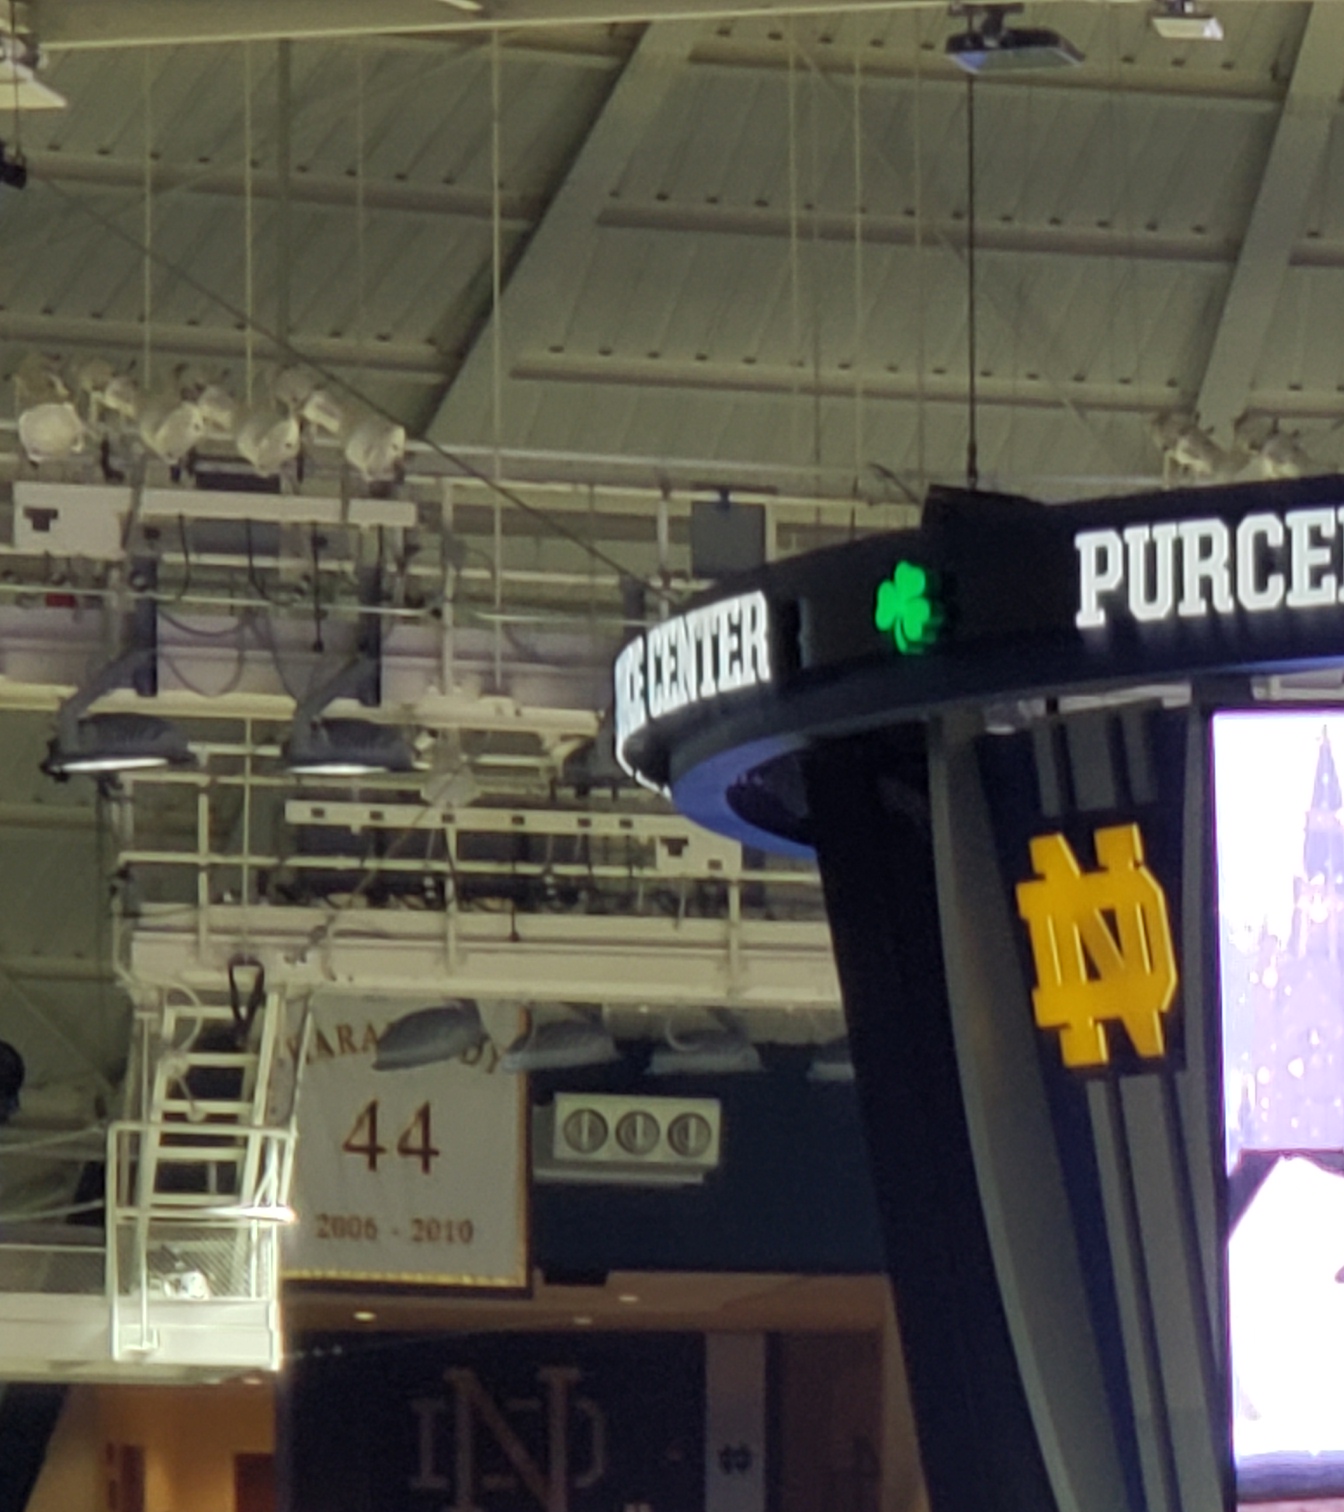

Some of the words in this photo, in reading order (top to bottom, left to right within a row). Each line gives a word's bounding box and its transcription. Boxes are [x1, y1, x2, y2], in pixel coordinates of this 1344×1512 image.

[647, 589, 771, 719] CENTER
[342, 1098, 440, 1175] 44
[315, 1212, 378, 1240] 2006
[411, 1218, 475, 1244] 2010
